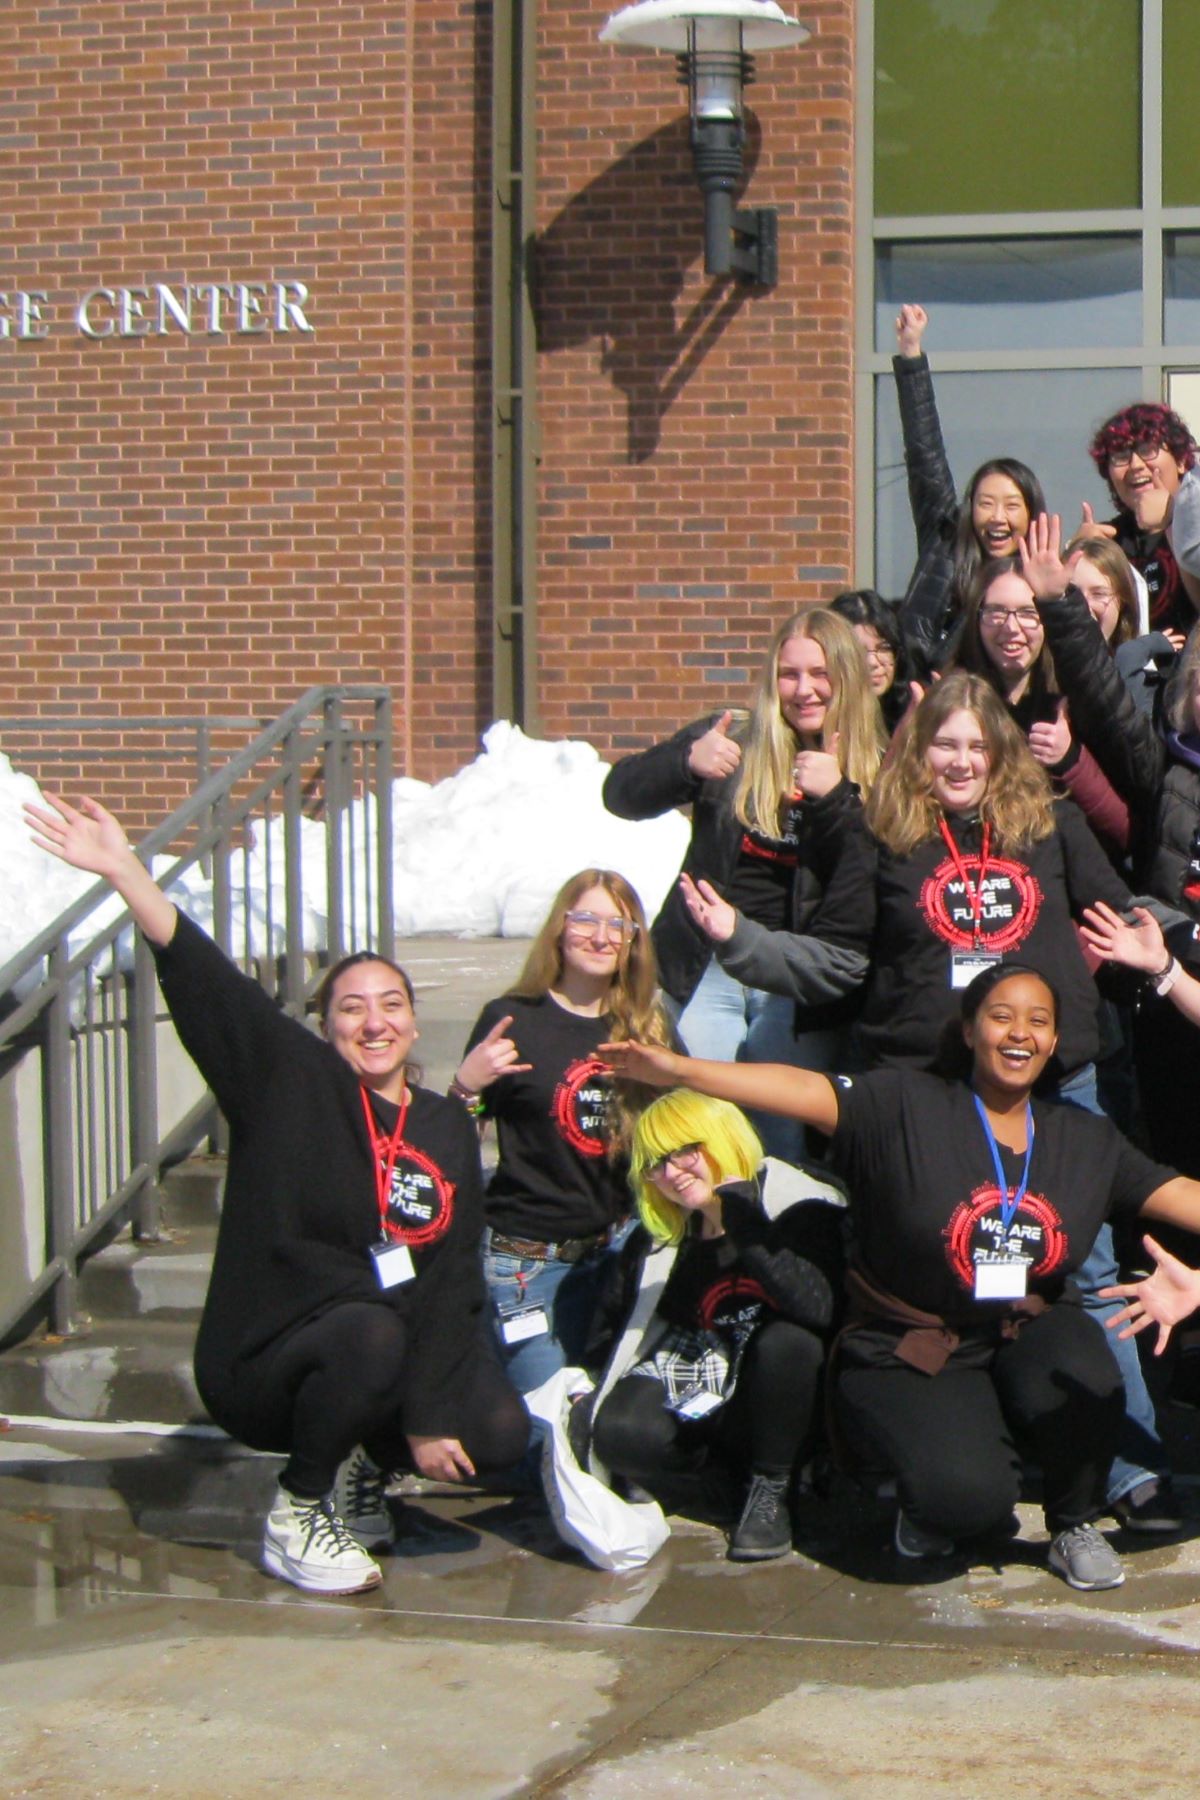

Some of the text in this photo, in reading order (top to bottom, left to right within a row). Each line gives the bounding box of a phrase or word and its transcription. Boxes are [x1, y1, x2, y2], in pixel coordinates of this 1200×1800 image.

[78, 282, 315, 340] CENTER
[948, 877, 1011, 894] WE ARE
[388, 1189, 433, 1220] UTURE
[1008, 1223, 1042, 1241] ARE
